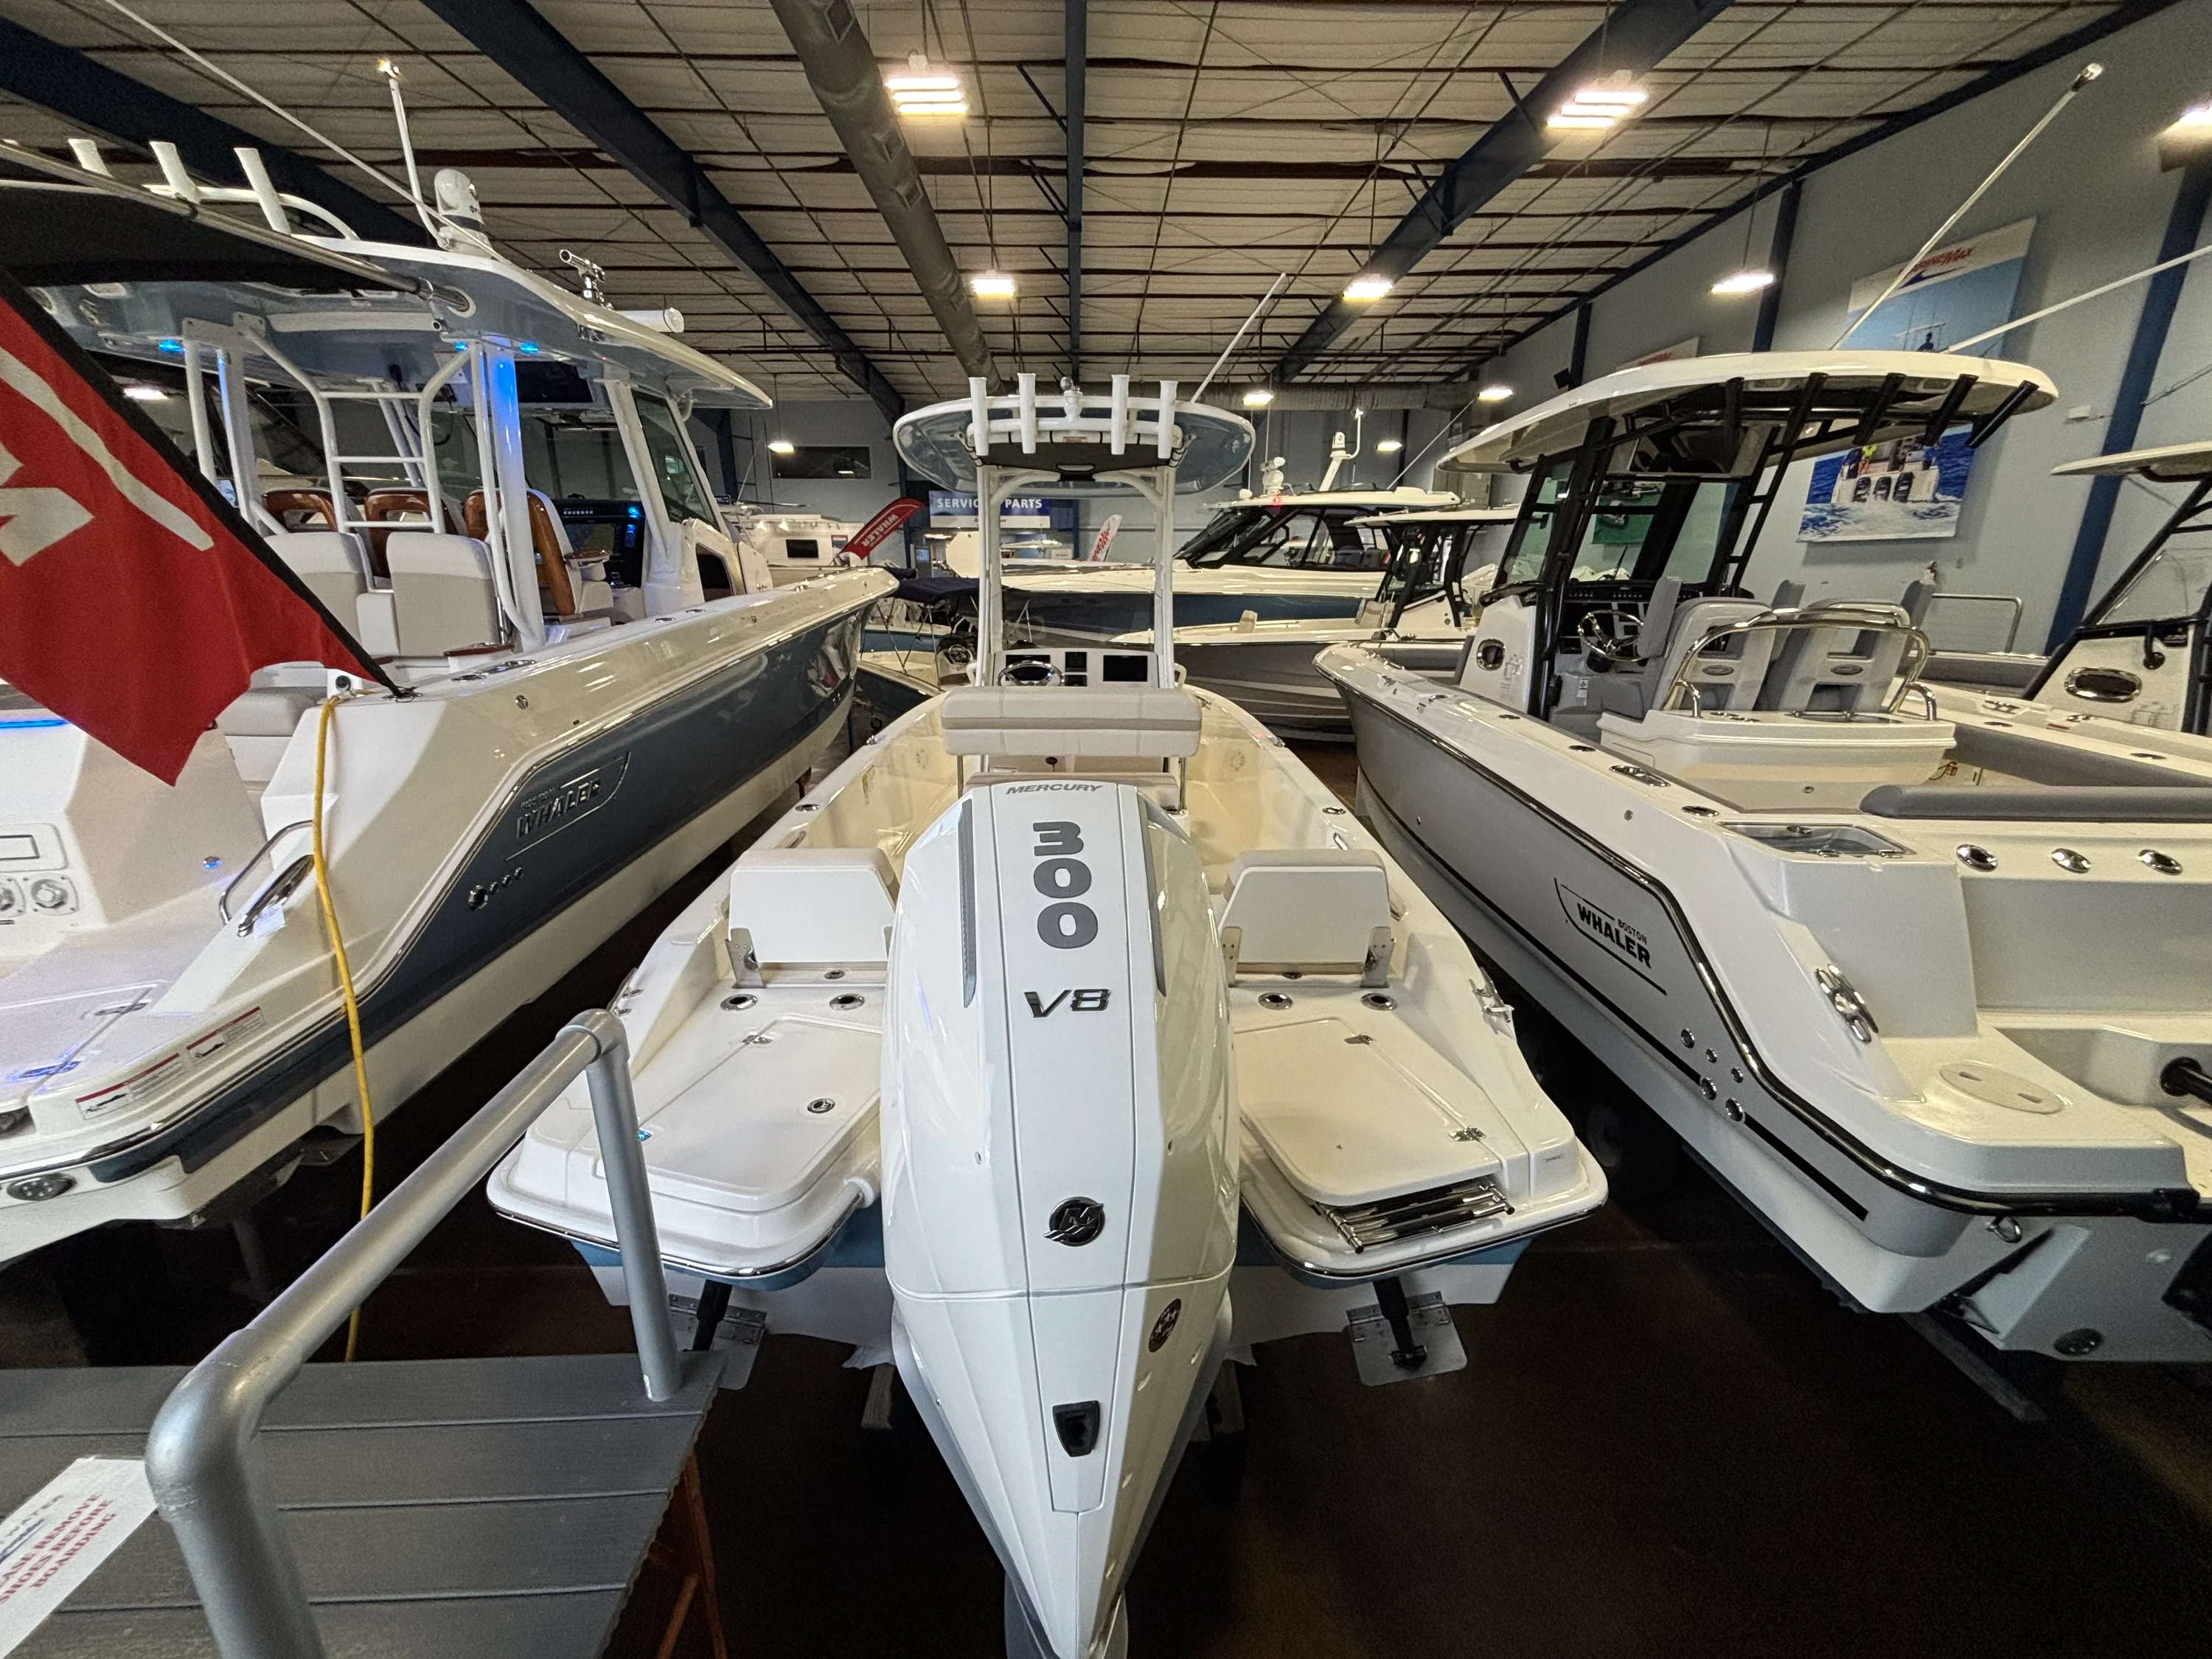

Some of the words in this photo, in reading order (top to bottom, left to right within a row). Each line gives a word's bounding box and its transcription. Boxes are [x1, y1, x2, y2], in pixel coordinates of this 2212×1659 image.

[936, 498, 979, 508] SERVIC
[1005, 498, 1042, 508] PARTS
[861, 514, 898, 546] WHALER
[1006, 783, 1103, 795] MERCURY
[1032, 821, 1099, 949] 300
[1577, 902, 1652, 970] WHALER
[1617, 919, 1647, 945] BOSTON
[1023, 988, 1111, 1018] V8
[33, 1493, 102, 1549] REMOVE
[0, 1554, 54, 1604] SHOES
[49, 1500, 114, 1551] BEFORE
[29, 1513, 117, 1590] BOARDING
